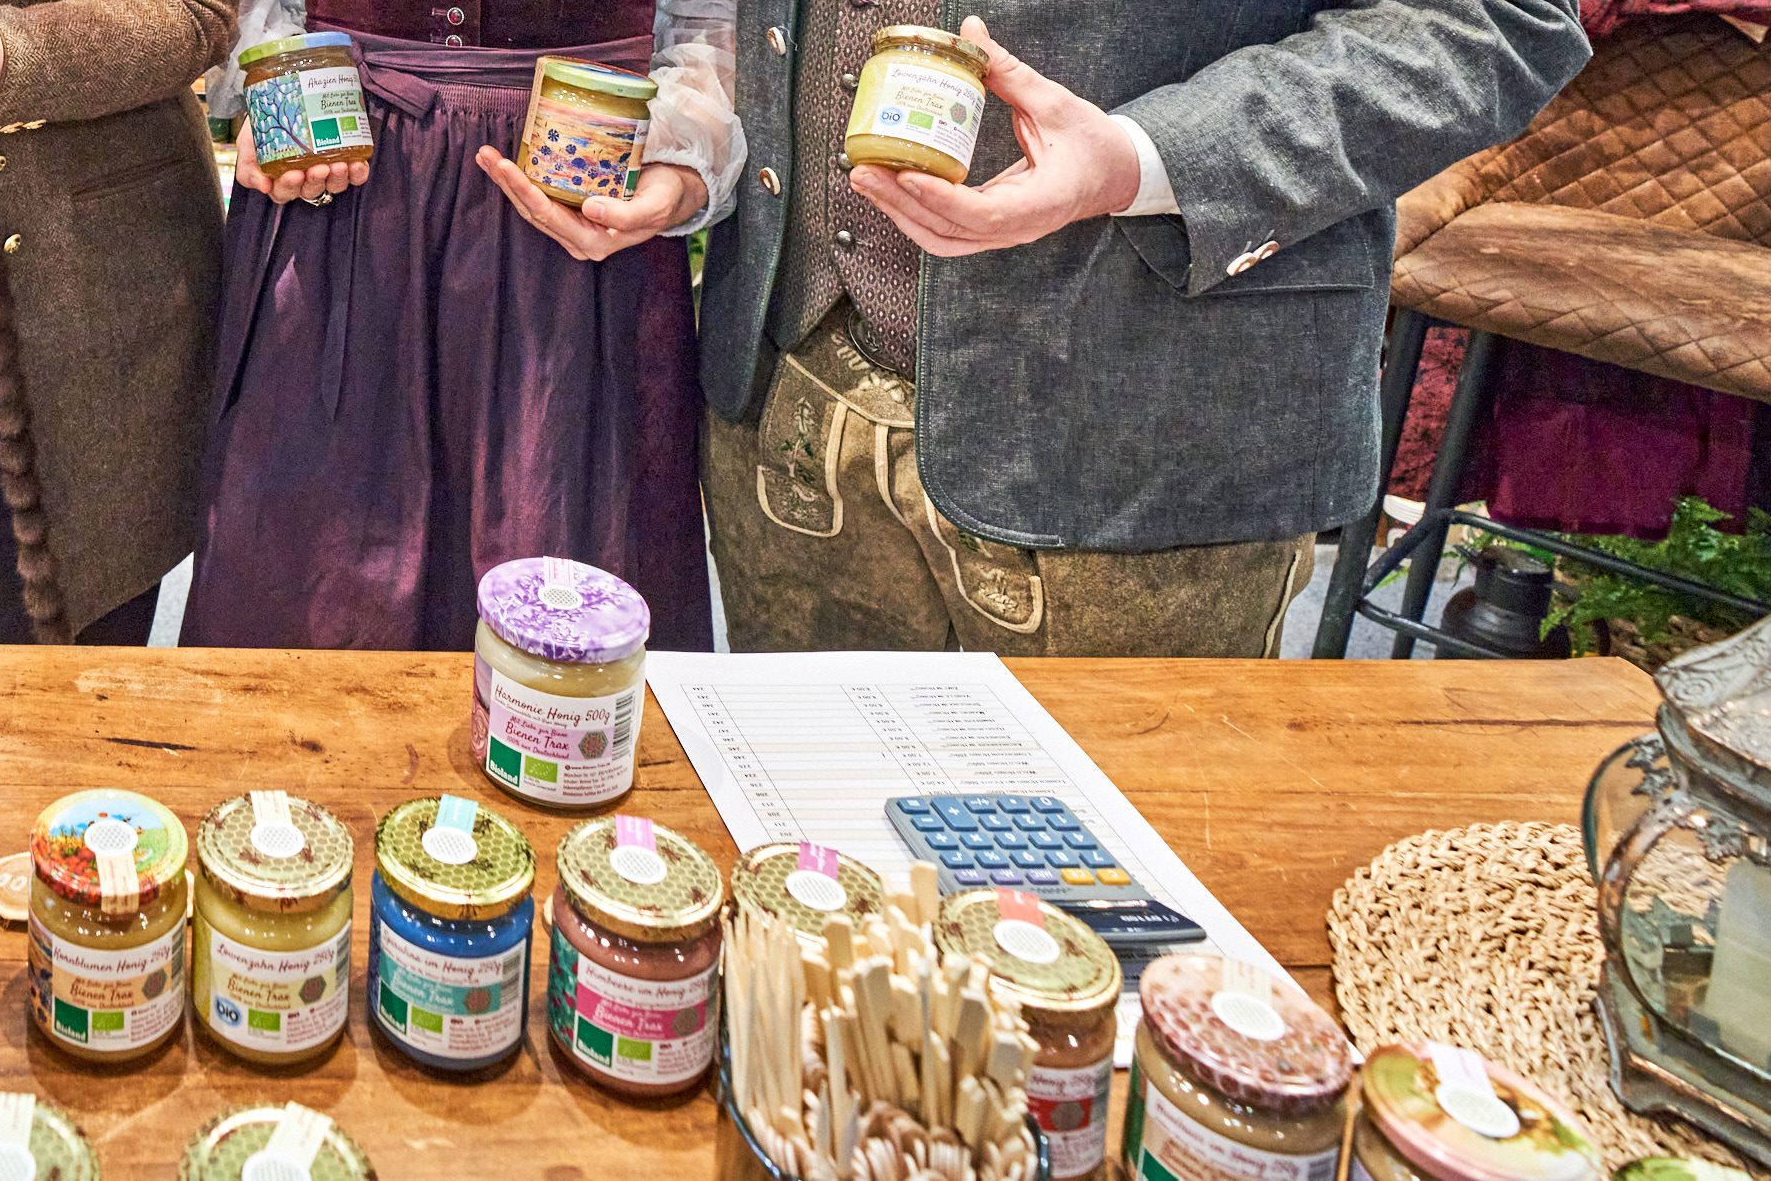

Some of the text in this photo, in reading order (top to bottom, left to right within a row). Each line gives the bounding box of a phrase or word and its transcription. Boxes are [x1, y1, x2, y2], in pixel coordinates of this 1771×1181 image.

[308, 77, 337, 89] Akazien
[939, 79, 962, 97] Honig
[963, 88, 976, 106] 250g
[321, 99, 345, 111] Bienen
[895, 91, 945, 110] Bienen Trax
[315, 136, 341, 147] Bioland
[494, 684, 545, 716] Harmonie
[546, 707, 581, 727] Honig
[585, 708, 611, 726] 500g
[505, 721, 570, 751] Bienen Trax
[489, 759, 519, 785] Bioland
[116, 959, 147, 974] Honig
[278, 959, 310, 973] Honig
[442, 959, 475, 981] Honig
[70, 983, 134, 1002] Bienen Trax
[227, 978, 262, 1000] Bienen
